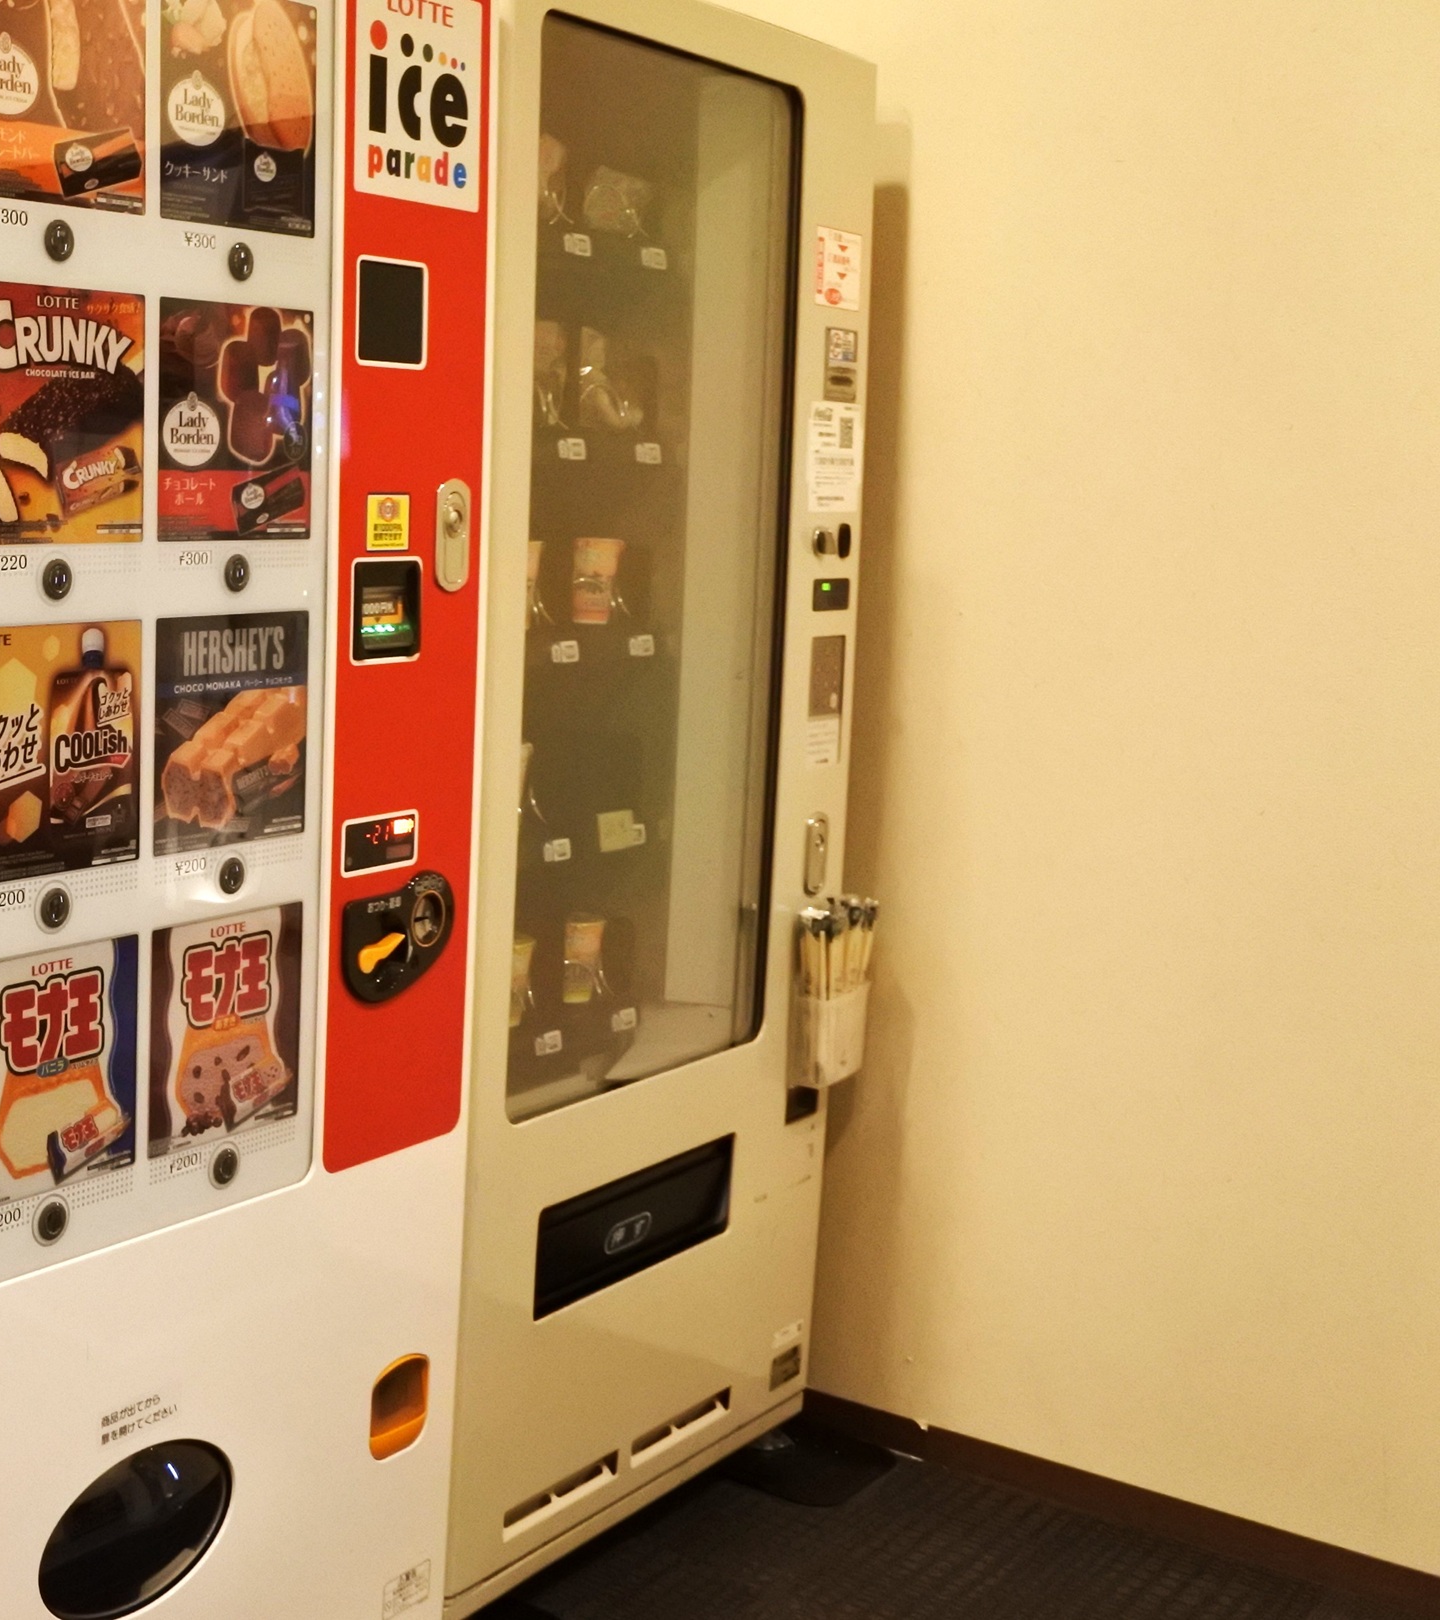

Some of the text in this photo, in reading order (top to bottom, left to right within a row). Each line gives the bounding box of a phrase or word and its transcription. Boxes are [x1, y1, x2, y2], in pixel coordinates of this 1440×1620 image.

[387, 0, 454, 28] LOTTE
[369, 20, 468, 148] ice
[184, 89, 214, 112] Lady
[176, 104, 218, 127] Borden
[165, 161, 227, 183] クッキーサンド
[368, 144, 467, 189] parade
[37, 295, 79, 310] LOTTE
[25, 369, 95, 379] CHOCOLATE ICE BAR
[179, 411, 209, 431] Lady
[170, 428, 214, 445] Borden
[63, 460, 117, 490] CRUNKY
[164, 477, 216, 491] チョコレート
[183, 625, 285, 676] HERSHEY'S
[100, 688, 129, 706] ゴクッと
[174, 683, 204, 694] CHOCO
[205, 680, 241, 691] MONAKA
[98, 701, 129, 720] しあわせ
[175, 858, 207, 876] ¥200
[211, 922, 246, 938] LOTTE
[32, 957, 73, 977] LOTTE
[183, 934, 270, 1026] モナ王
[1, 970, 102, 1072] モナ王
[41, 1060, 65, 1076] バニラ
[61, 1114, 99, 1152] モナ王
